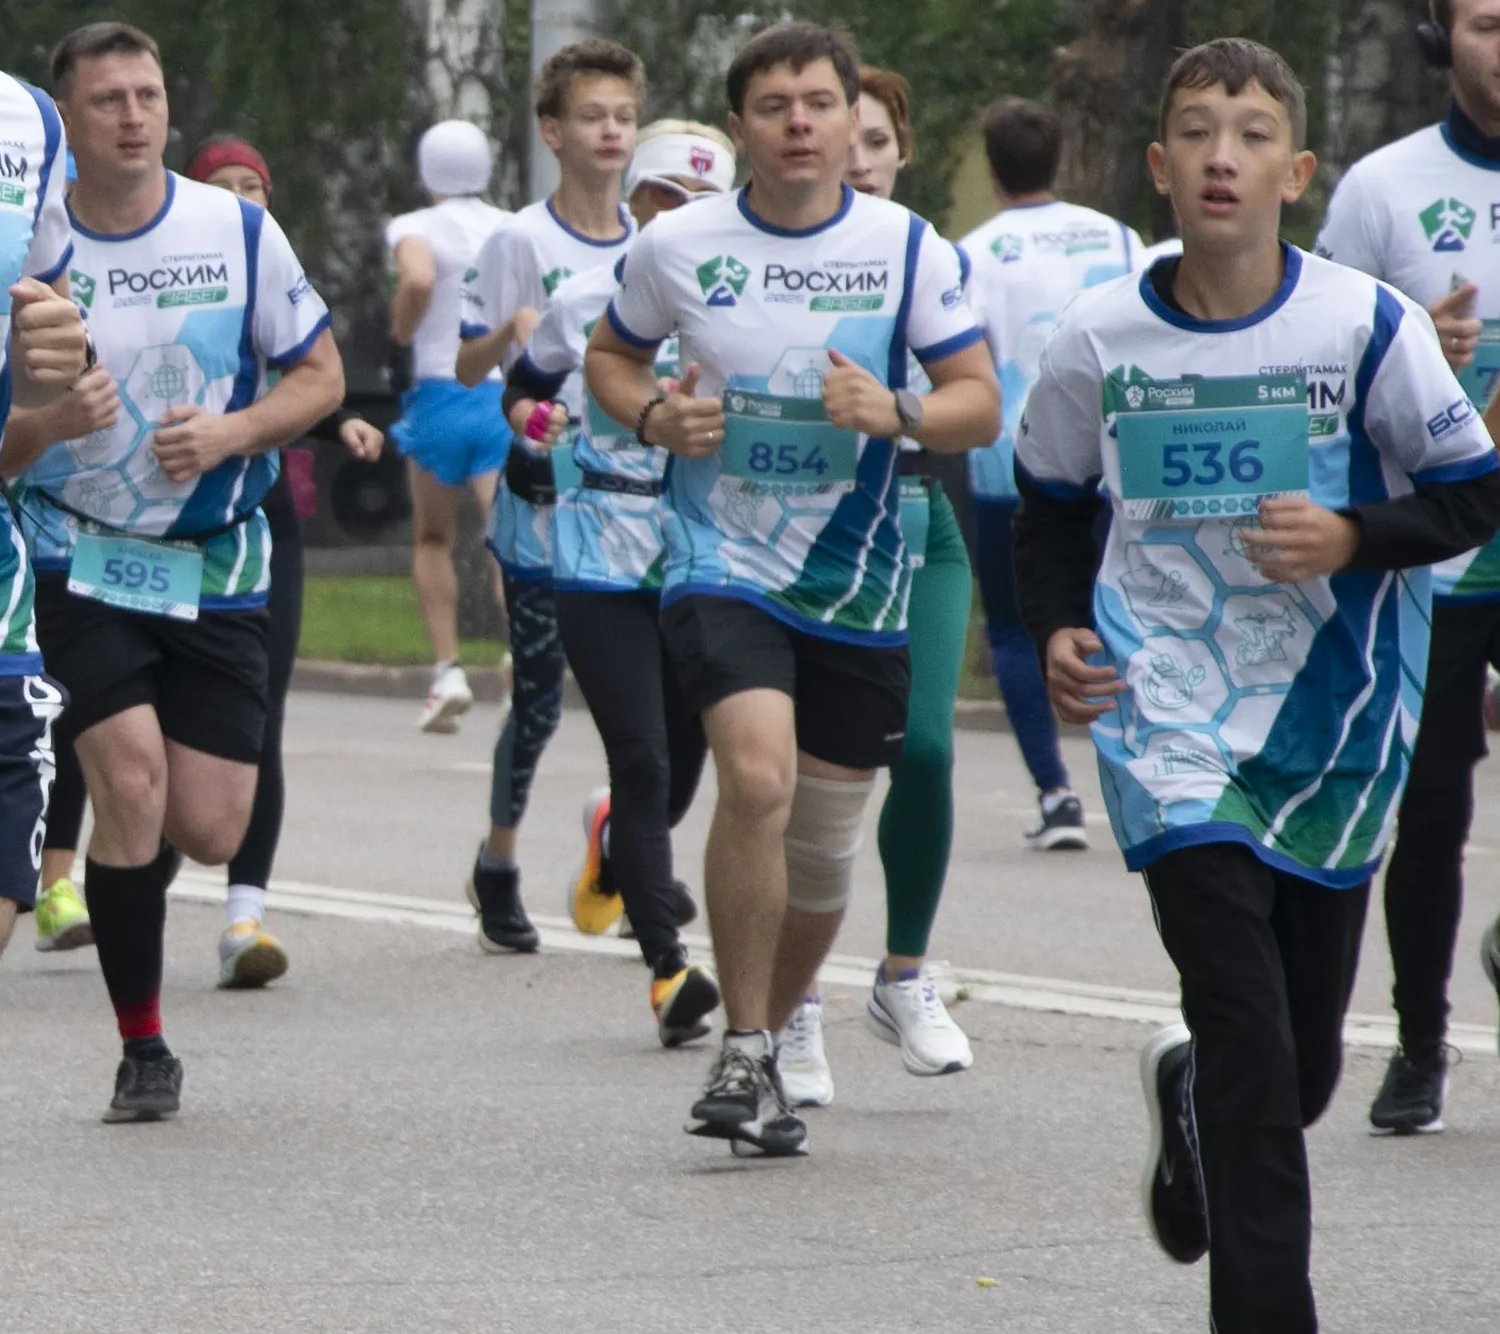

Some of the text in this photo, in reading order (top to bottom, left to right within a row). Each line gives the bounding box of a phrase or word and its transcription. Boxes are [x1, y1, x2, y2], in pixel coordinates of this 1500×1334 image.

[161, 287, 222, 307] ЗАБЕГ
[1257, 385, 1269, 399] 5
[1172, 418, 1248, 436] НИКОЛАЙ
[748, 440, 830, 476] 854
[1161, 439, 1265, 487] 536
[102, 557, 172, 594] 595
